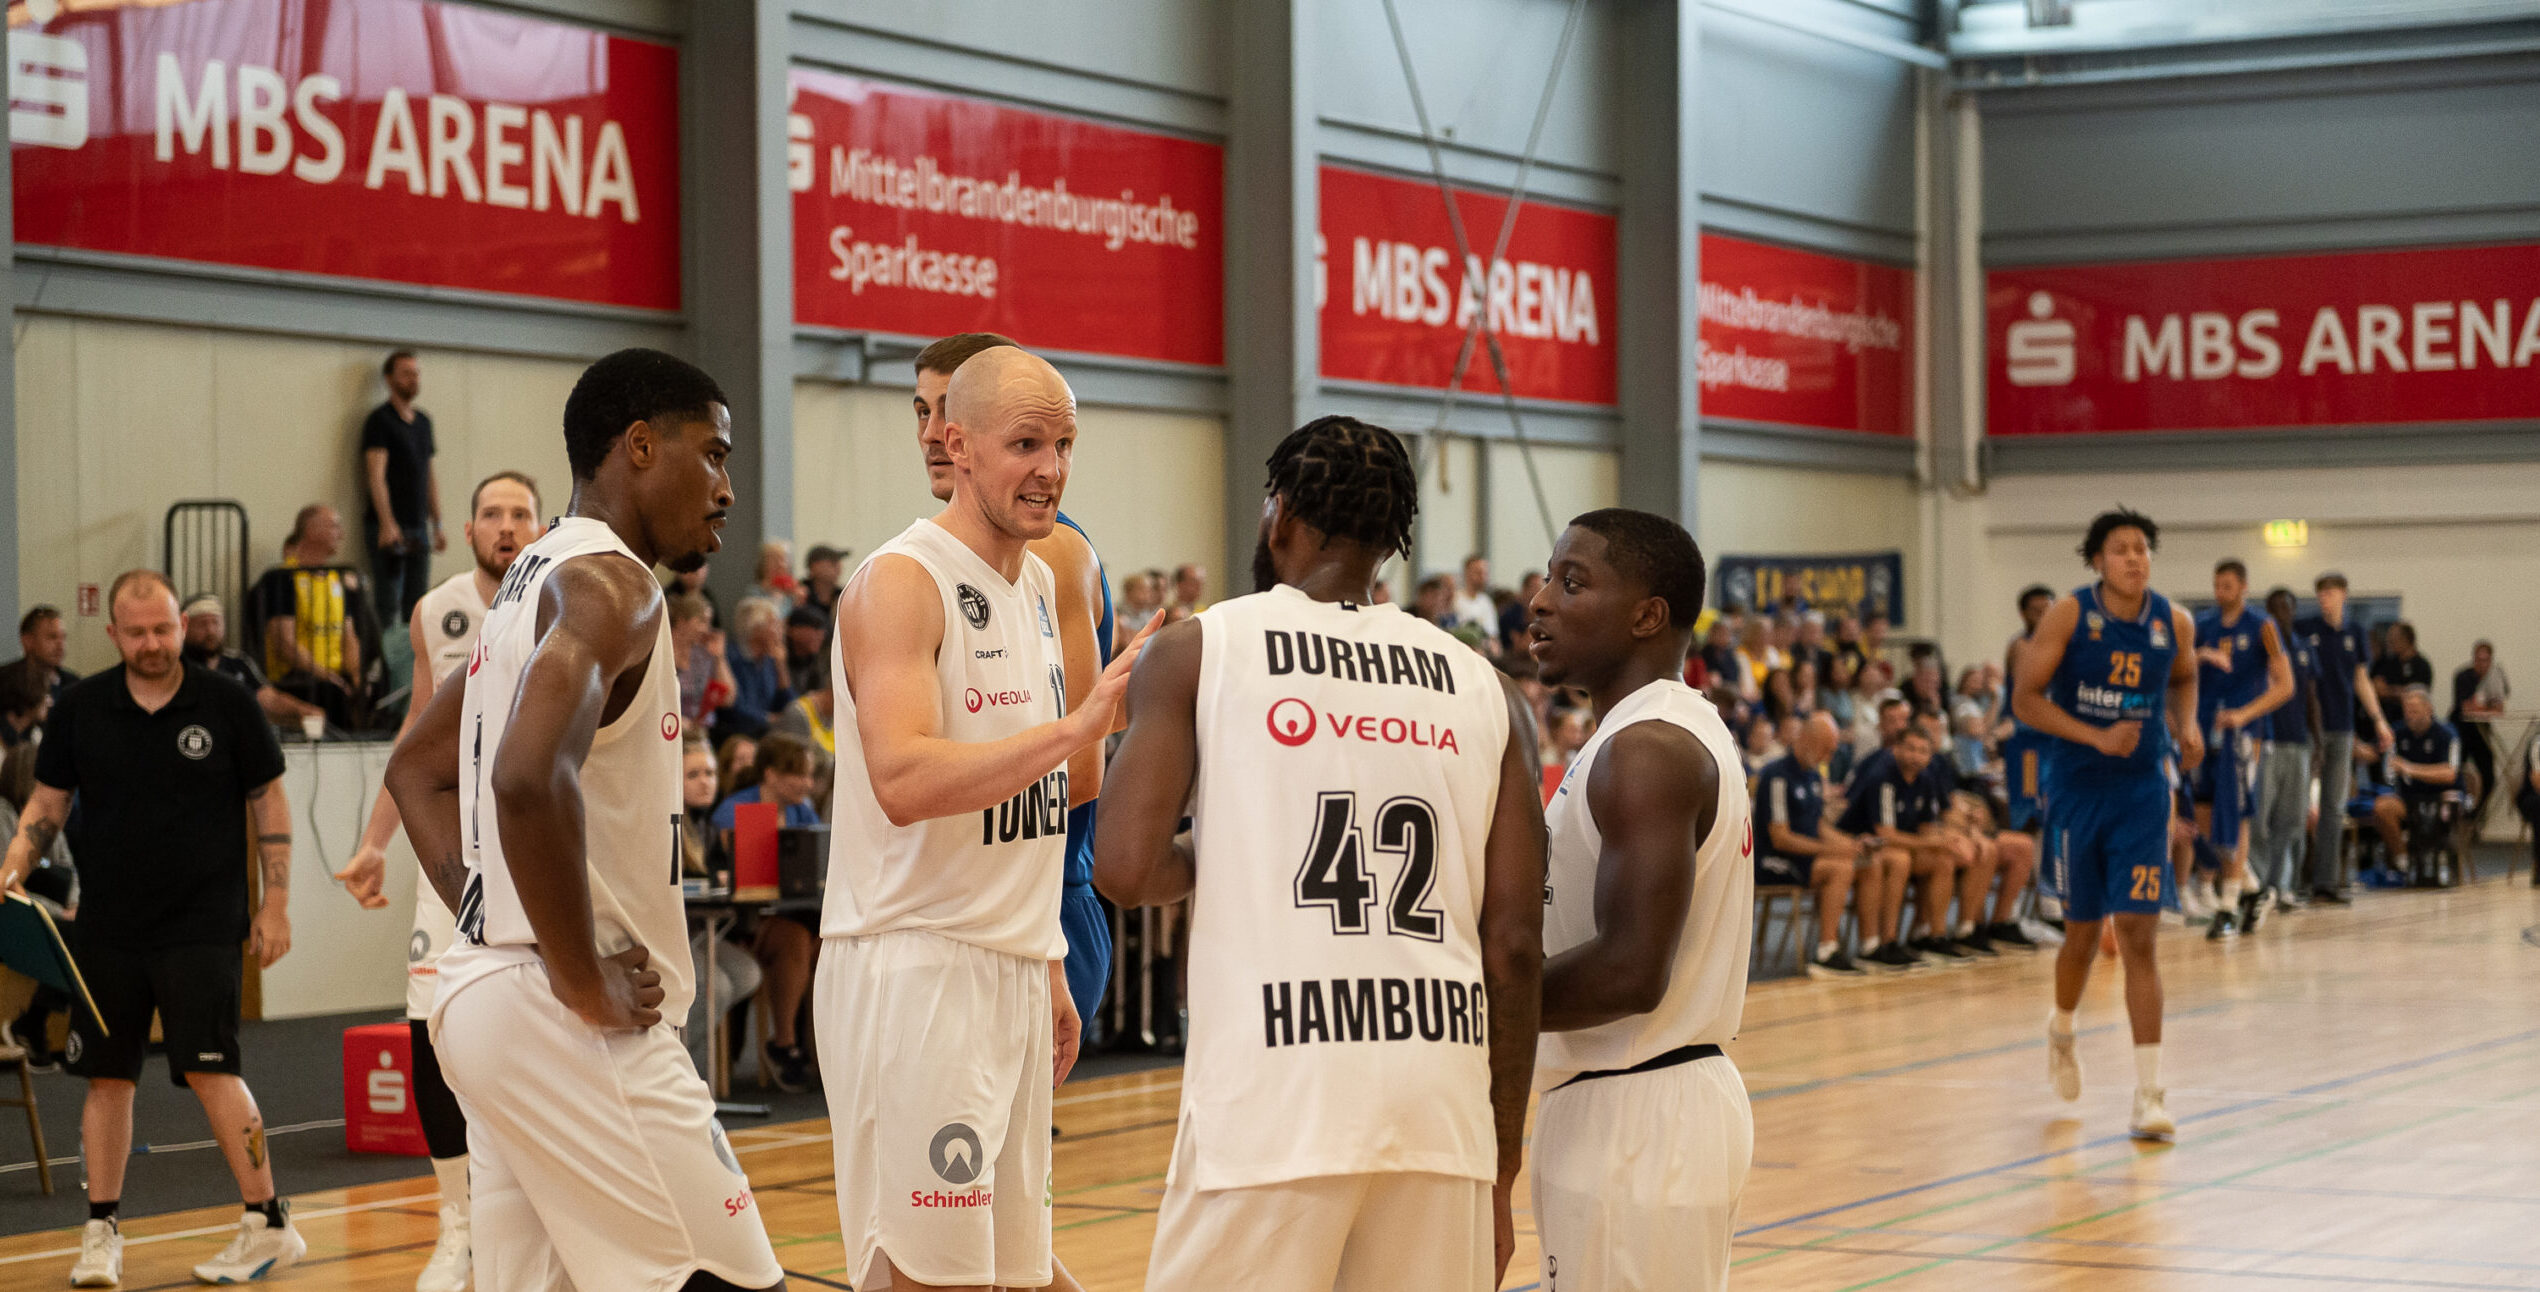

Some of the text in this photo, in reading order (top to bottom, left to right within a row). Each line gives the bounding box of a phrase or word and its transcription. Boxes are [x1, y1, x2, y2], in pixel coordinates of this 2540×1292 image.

[155, 52, 640, 223] MBS ARENA
[830, 145, 1199, 252] Mittelbrandenburgische
[829, 225, 998, 299] Sparkasse
[1353, 236, 1599, 346] MBS ARENA
[2122, 309, 2282, 383] MBS
[975, 649, 1003, 659] CRAFT
[1264, 629, 1456, 695] DURHAM
[2108, 650, 2143, 688] 25
[987, 689, 1032, 706] VEOLIA
[1326, 712, 1460, 756] VEOLIA
[1294, 791, 1444, 943] 42
[2130, 865, 2161, 901] 25
[1262, 977, 1484, 1049] HAMBURG
[911, 1190, 992, 1208] Schindler
